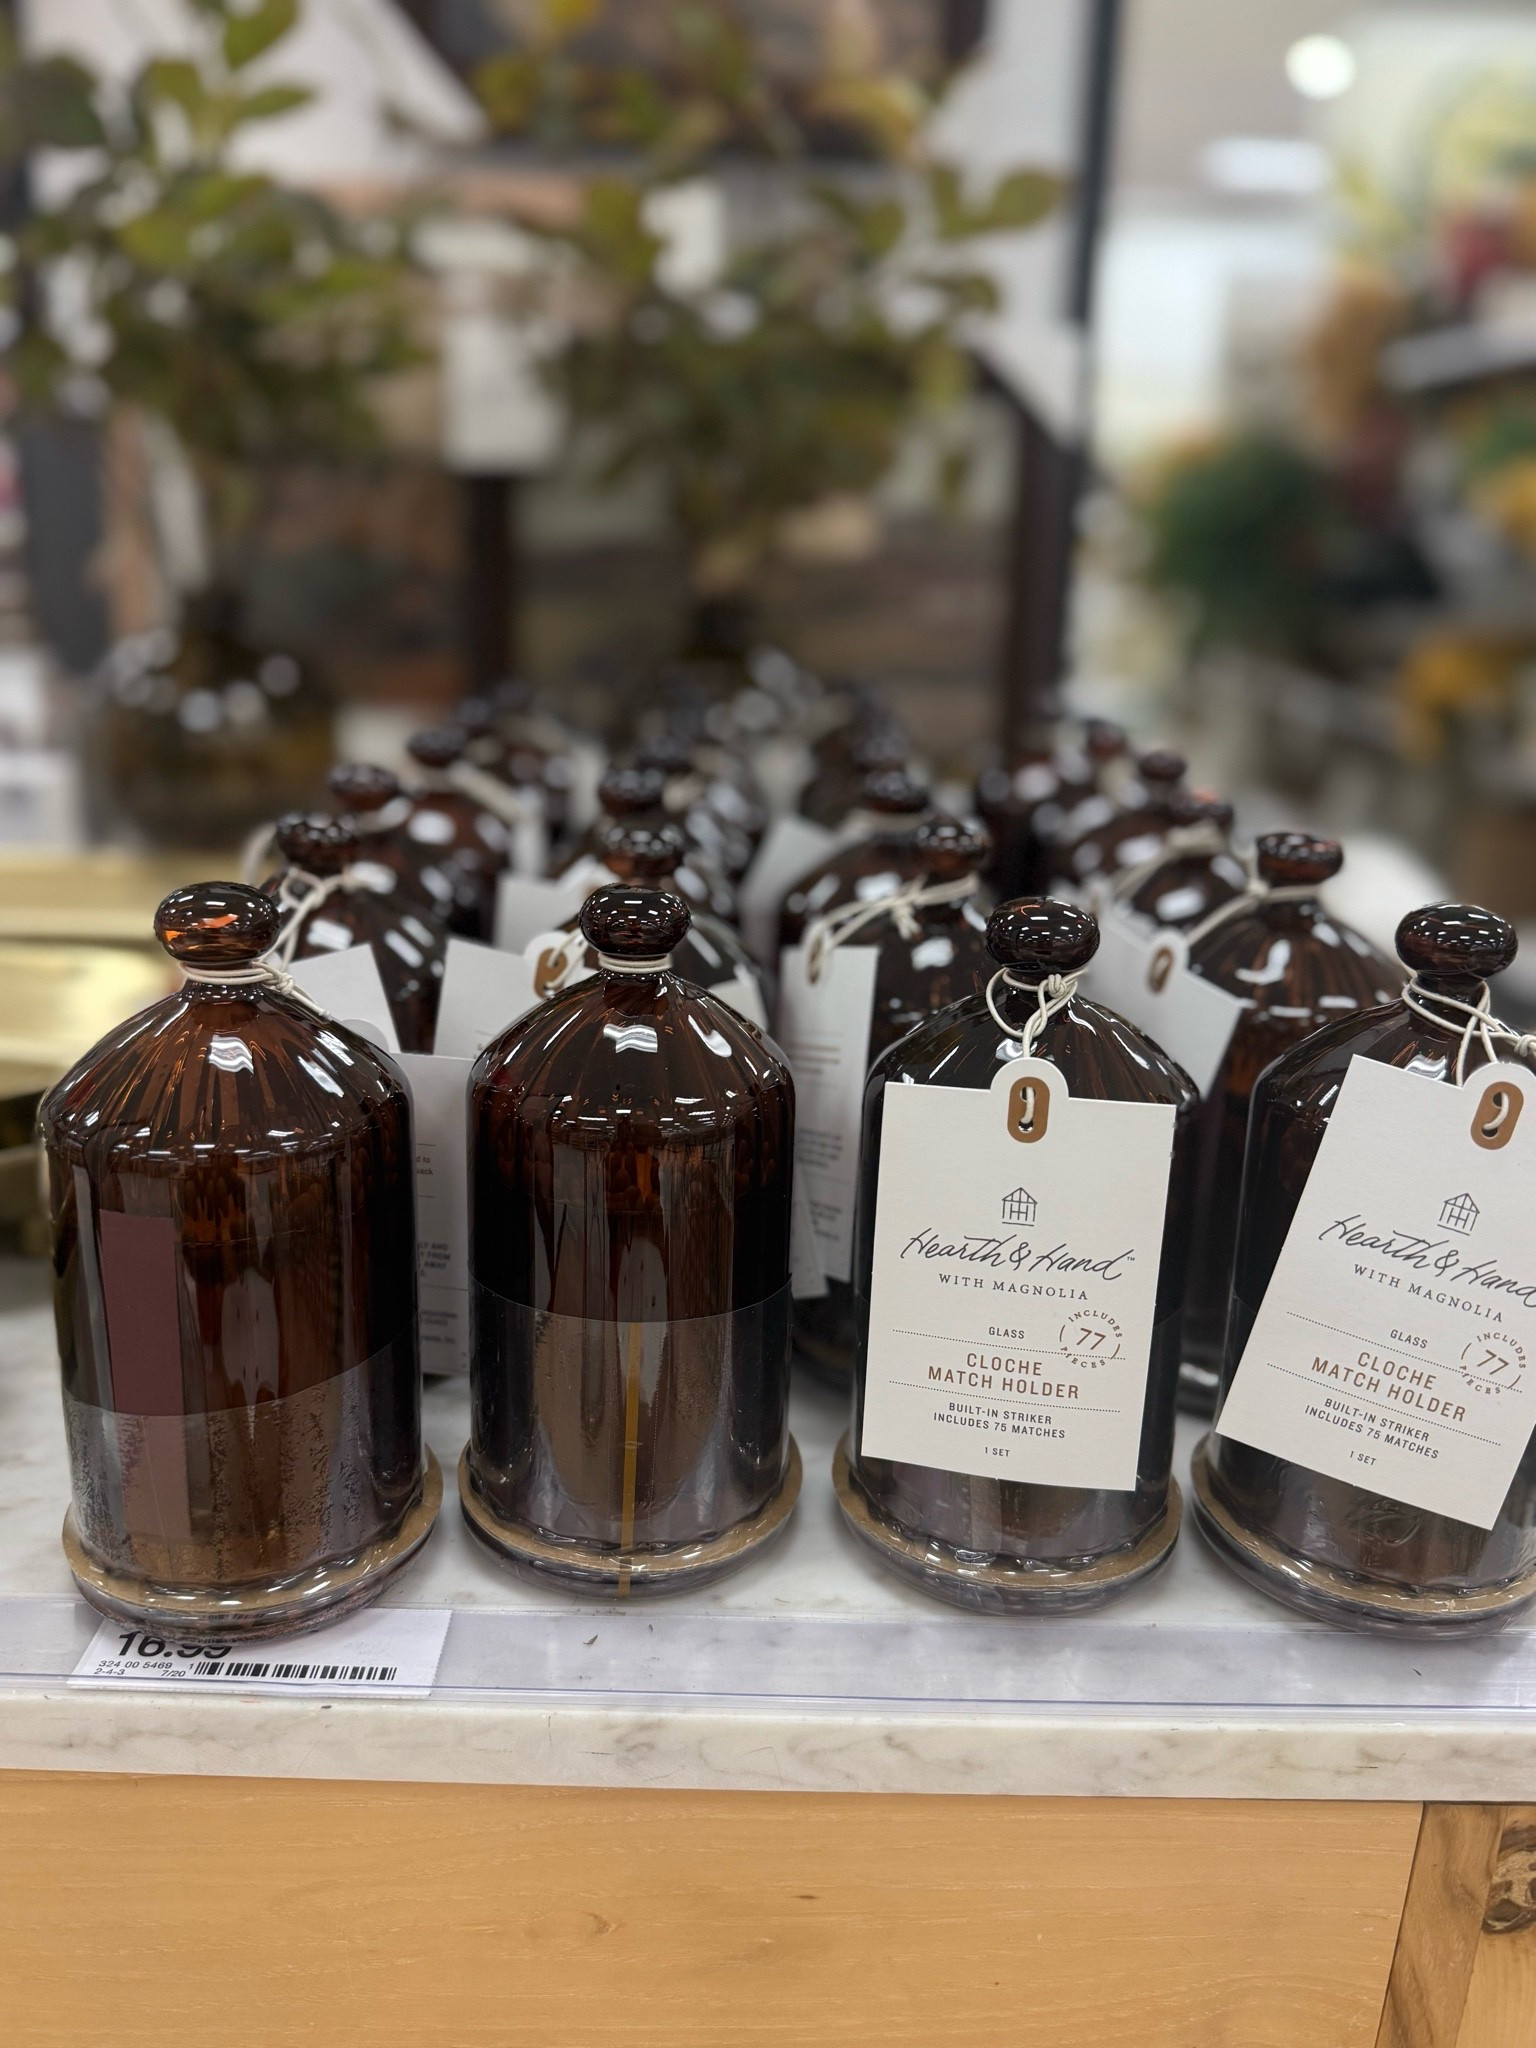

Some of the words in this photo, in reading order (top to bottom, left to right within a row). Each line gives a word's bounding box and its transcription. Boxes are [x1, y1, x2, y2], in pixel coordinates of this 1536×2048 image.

[900, 1227, 1017, 1267] Hearth
[1008, 1241, 1032, 1271] &
[1318, 1214, 1449, 1269] Hearth
[1434, 1249, 1459, 1277] &
[939, 1273, 984, 1289] WITH
[992, 1280, 1088, 1301] MAGNOLIA
[1353, 1263, 1401, 1289] WITH
[1407, 1283, 1503, 1323] MAGNOLIA
[988, 1325, 1026, 1340] GLASS
[1068, 1309, 1122, 1338] INCLUDES
[1076, 1327, 1107, 1351] 77
[1390, 1329, 1428, 1349] GLASS
[1476, 1332, 1526, 1369] INCLUDES
[966, 1352, 1043, 1377] CLOCHE
[1060, 1346, 1106, 1369] PIECES
[1357, 1351, 1437, 1390] CLOCHE
[1476, 1349, 1510, 1375] 77
[928, 1365, 993, 1390] MATCH
[1002, 1377, 1079, 1400] HOLDER
[1311, 1356, 1381, 1393] MATCH
[1387, 1384, 1466, 1422] HOLDER
[1459, 1365, 1501, 1395] PIECES
[933, 1411, 989, 1430] INCLUDES
[994, 1421, 1007, 1432] 75
[1011, 1424, 1066, 1439] MATCHES
[949, 1402, 999, 1418] BUILT-IN
[1003, 1410, 1052, 1425] STRIKER
[1324, 1398, 1377, 1424] BUILT-IN
[1379, 1417, 1430, 1442] STRIKER
[1304, 1404, 1364, 1433] INCLUDES
[1366, 1427, 1381, 1440] 75
[1384, 1433, 1439, 1459] MATCHES
[992, 1447, 1011, 1457] SET
[1357, 1453, 1377, 1466] SET
[94, 1668, 125, 1676] 2-4-3
[98, 1660, 121, 1668] 324
[124, 1661, 140, 1669] 00
[142, 1661, 173, 1670] 5469
